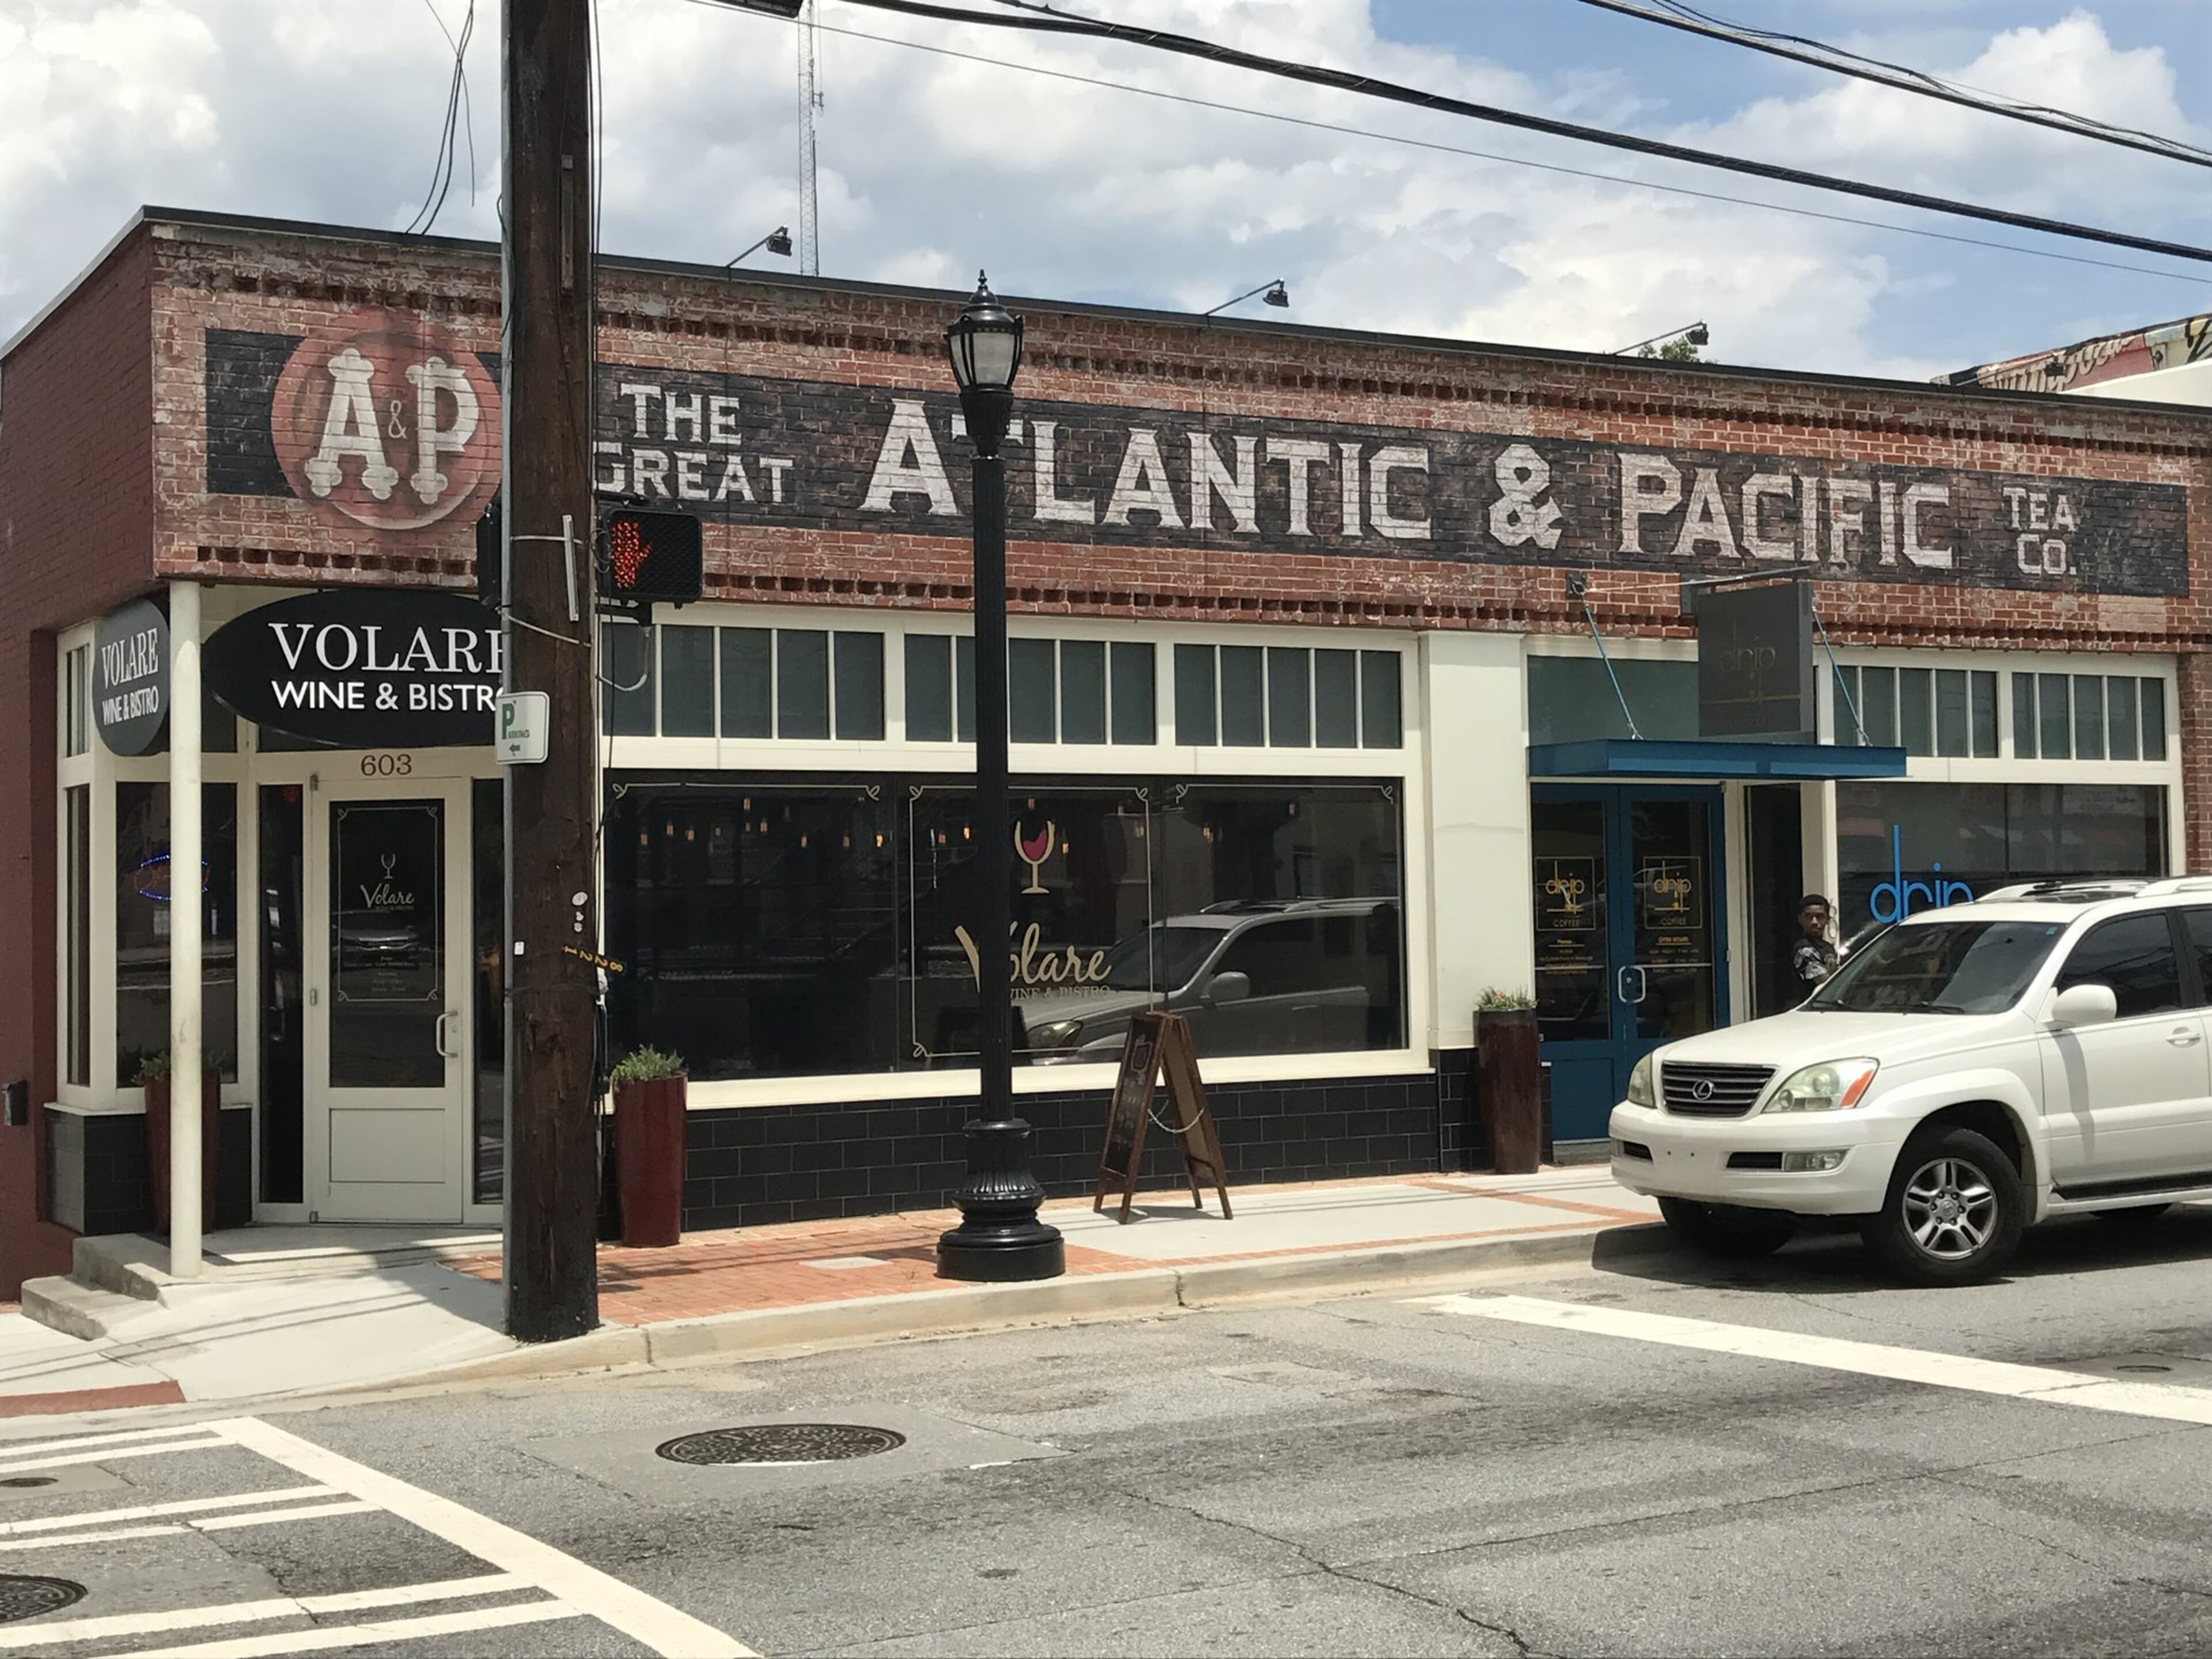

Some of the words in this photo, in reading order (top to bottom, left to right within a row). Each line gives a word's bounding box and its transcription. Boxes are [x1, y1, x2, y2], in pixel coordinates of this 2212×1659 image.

[620, 383, 742, 445] THE
[594, 441, 794, 502] GREAT
[858, 399, 1431, 539] ALANTIC
[1488, 444, 1563, 550] &
[1616, 452, 1953, 570] PACIFIC
[2003, 487, 2077, 532] TEA
[101, 627, 158, 690] VOLARE
[102, 696, 122, 726] WINE
[123, 694, 130, 721] &
[130, 685, 159, 719] BISTRO
[271, 680, 365, 710] WINE
[375, 682, 399, 710] &
[409, 683, 503, 711] BISTR
[361, 754, 412, 776] 603
[359, 882, 415, 908] Volare
[563, 945, 624, 974] 1228
[1010, 987, 1040, 1001] INE
